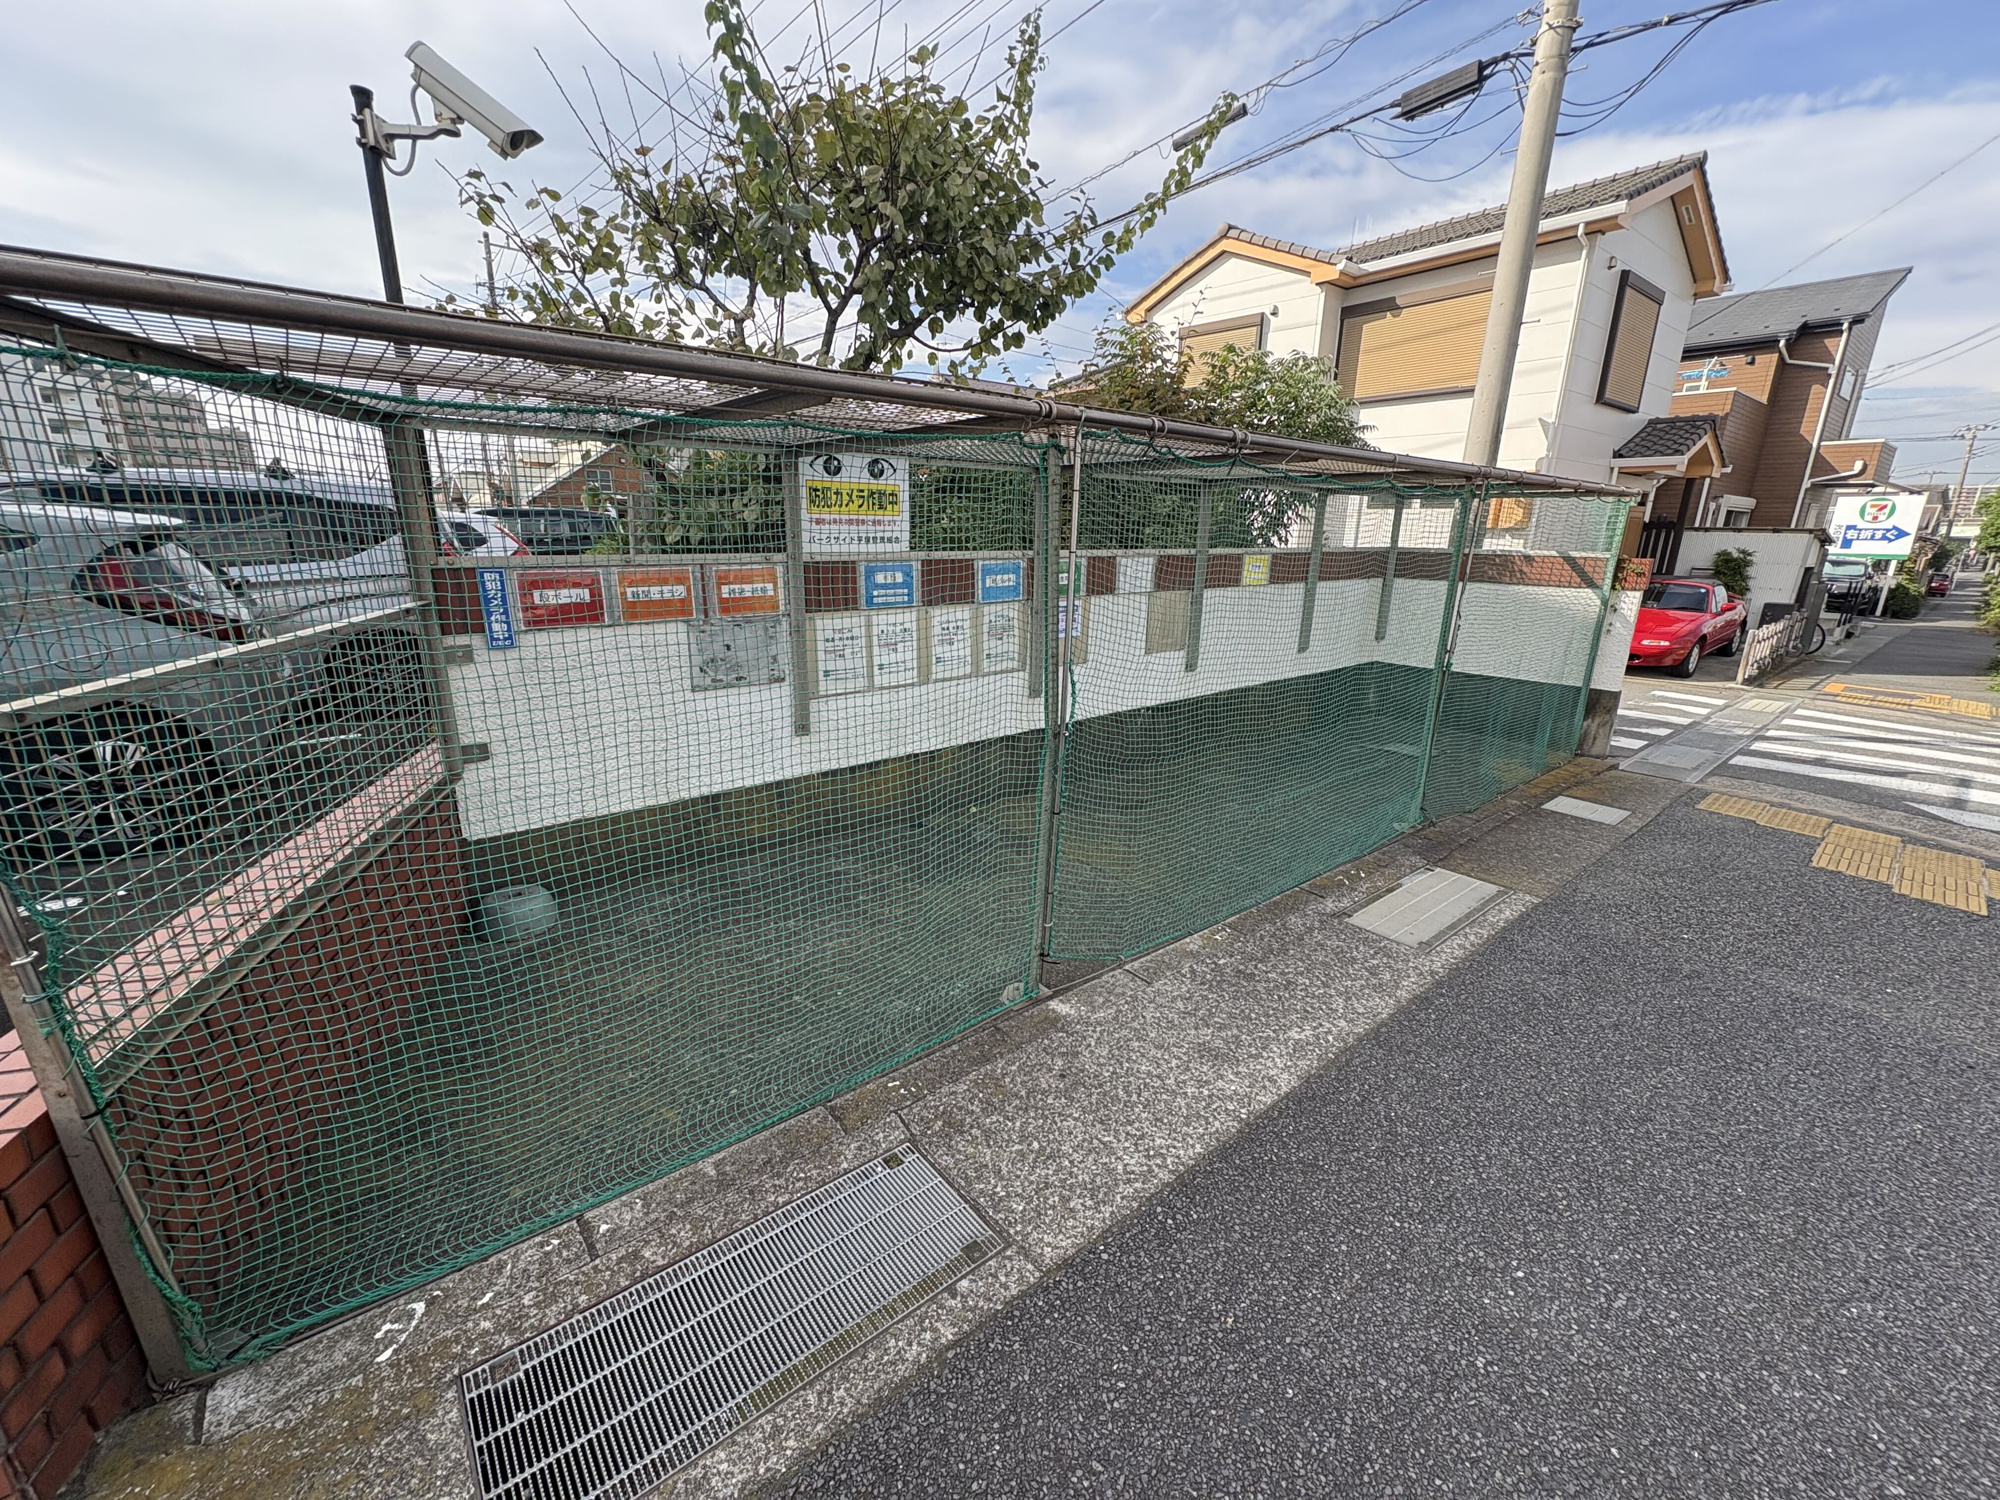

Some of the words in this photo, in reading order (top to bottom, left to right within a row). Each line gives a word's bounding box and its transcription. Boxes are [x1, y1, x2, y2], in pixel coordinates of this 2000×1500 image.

[808, 485, 899, 512] 防犯カメラ作動中
[1869, 503, 1889, 521] 7
[1845, 529, 1899, 540] 右折すぐ
[538, 591, 585, 603] 段ボール
[630, 588, 684, 600] 新聞・チラシ
[483, 572, 509, 640] 防犯カメラ作動中
